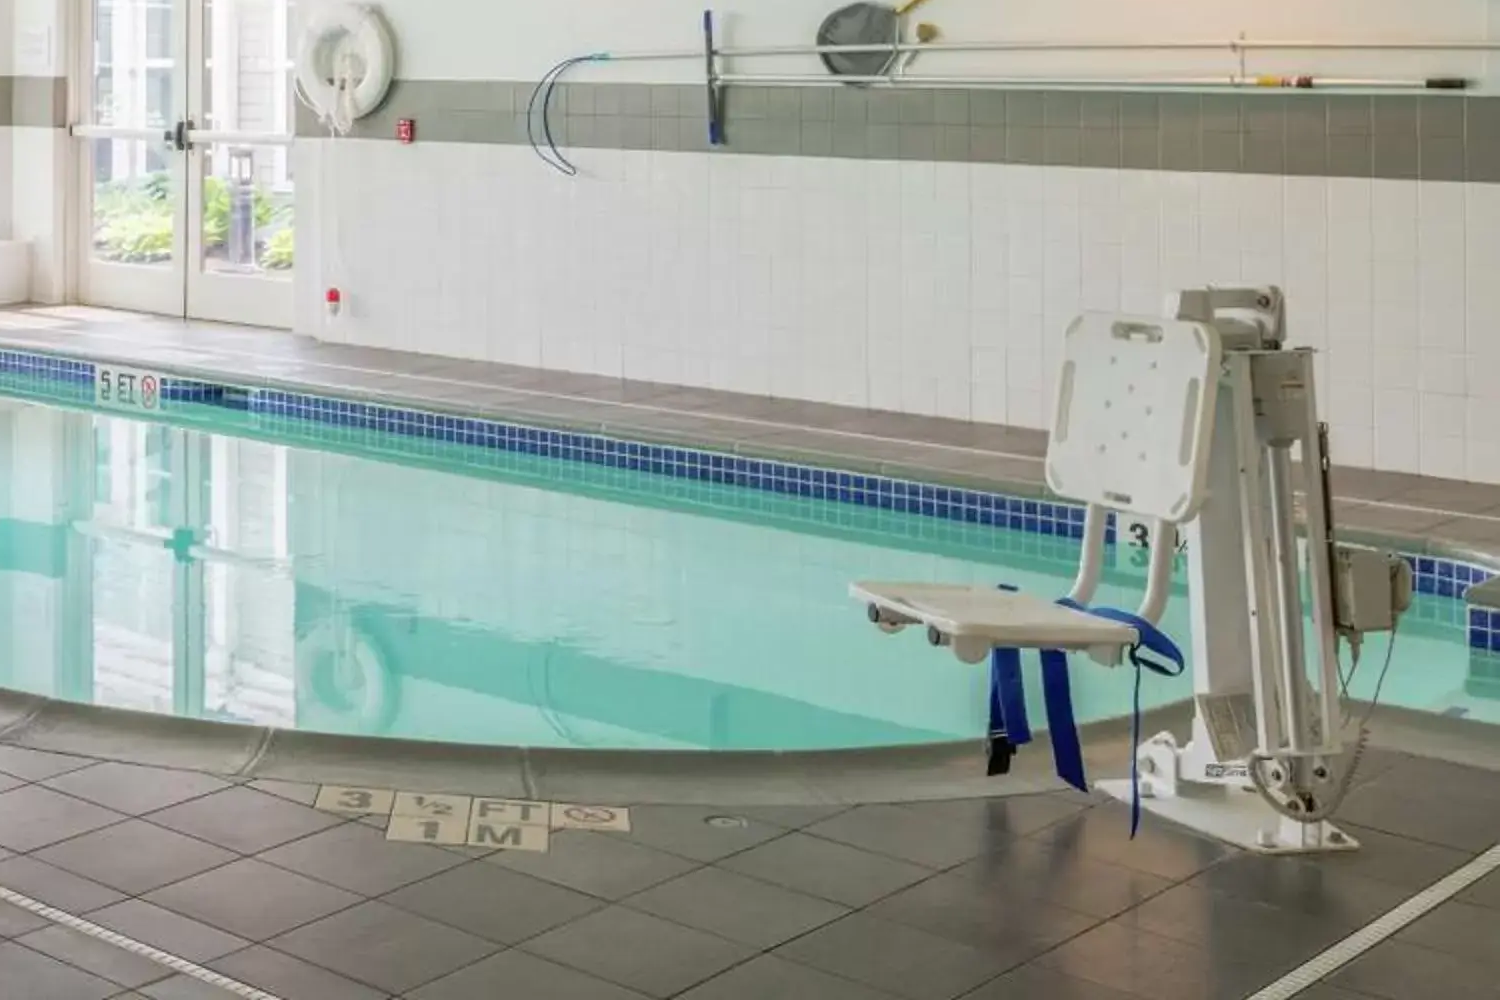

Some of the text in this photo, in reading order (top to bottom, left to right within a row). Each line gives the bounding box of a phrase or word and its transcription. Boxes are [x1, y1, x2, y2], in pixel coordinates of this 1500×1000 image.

[1128, 523, 1149, 549] 3
[336, 790, 373, 809] 3
[477, 800, 542, 822] FT
[417, 820, 522, 846] 1 M
